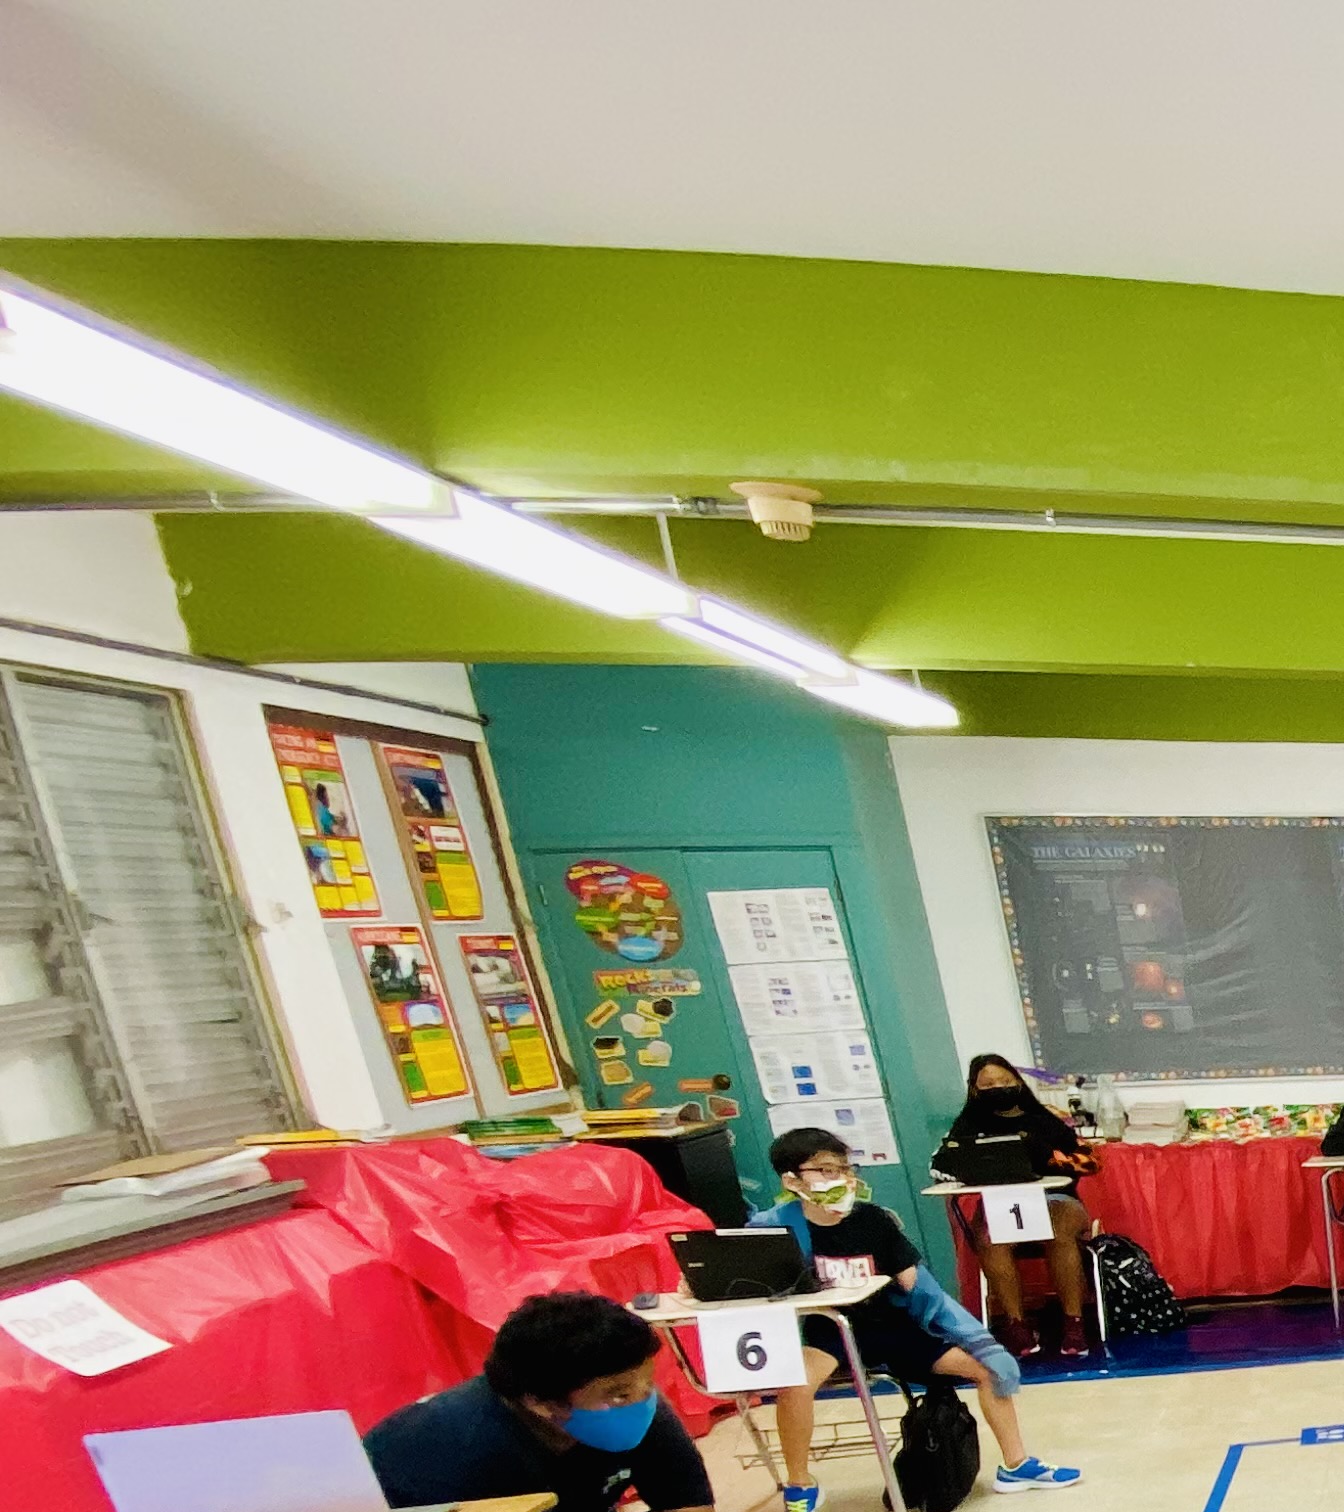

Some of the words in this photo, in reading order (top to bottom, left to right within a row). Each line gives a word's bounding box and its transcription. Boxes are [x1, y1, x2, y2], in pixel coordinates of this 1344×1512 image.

[1032, 846, 1057, 858] THE
[1009, 1203, 1024, 1230] 1
[736, 1331, 768, 1372] 6
